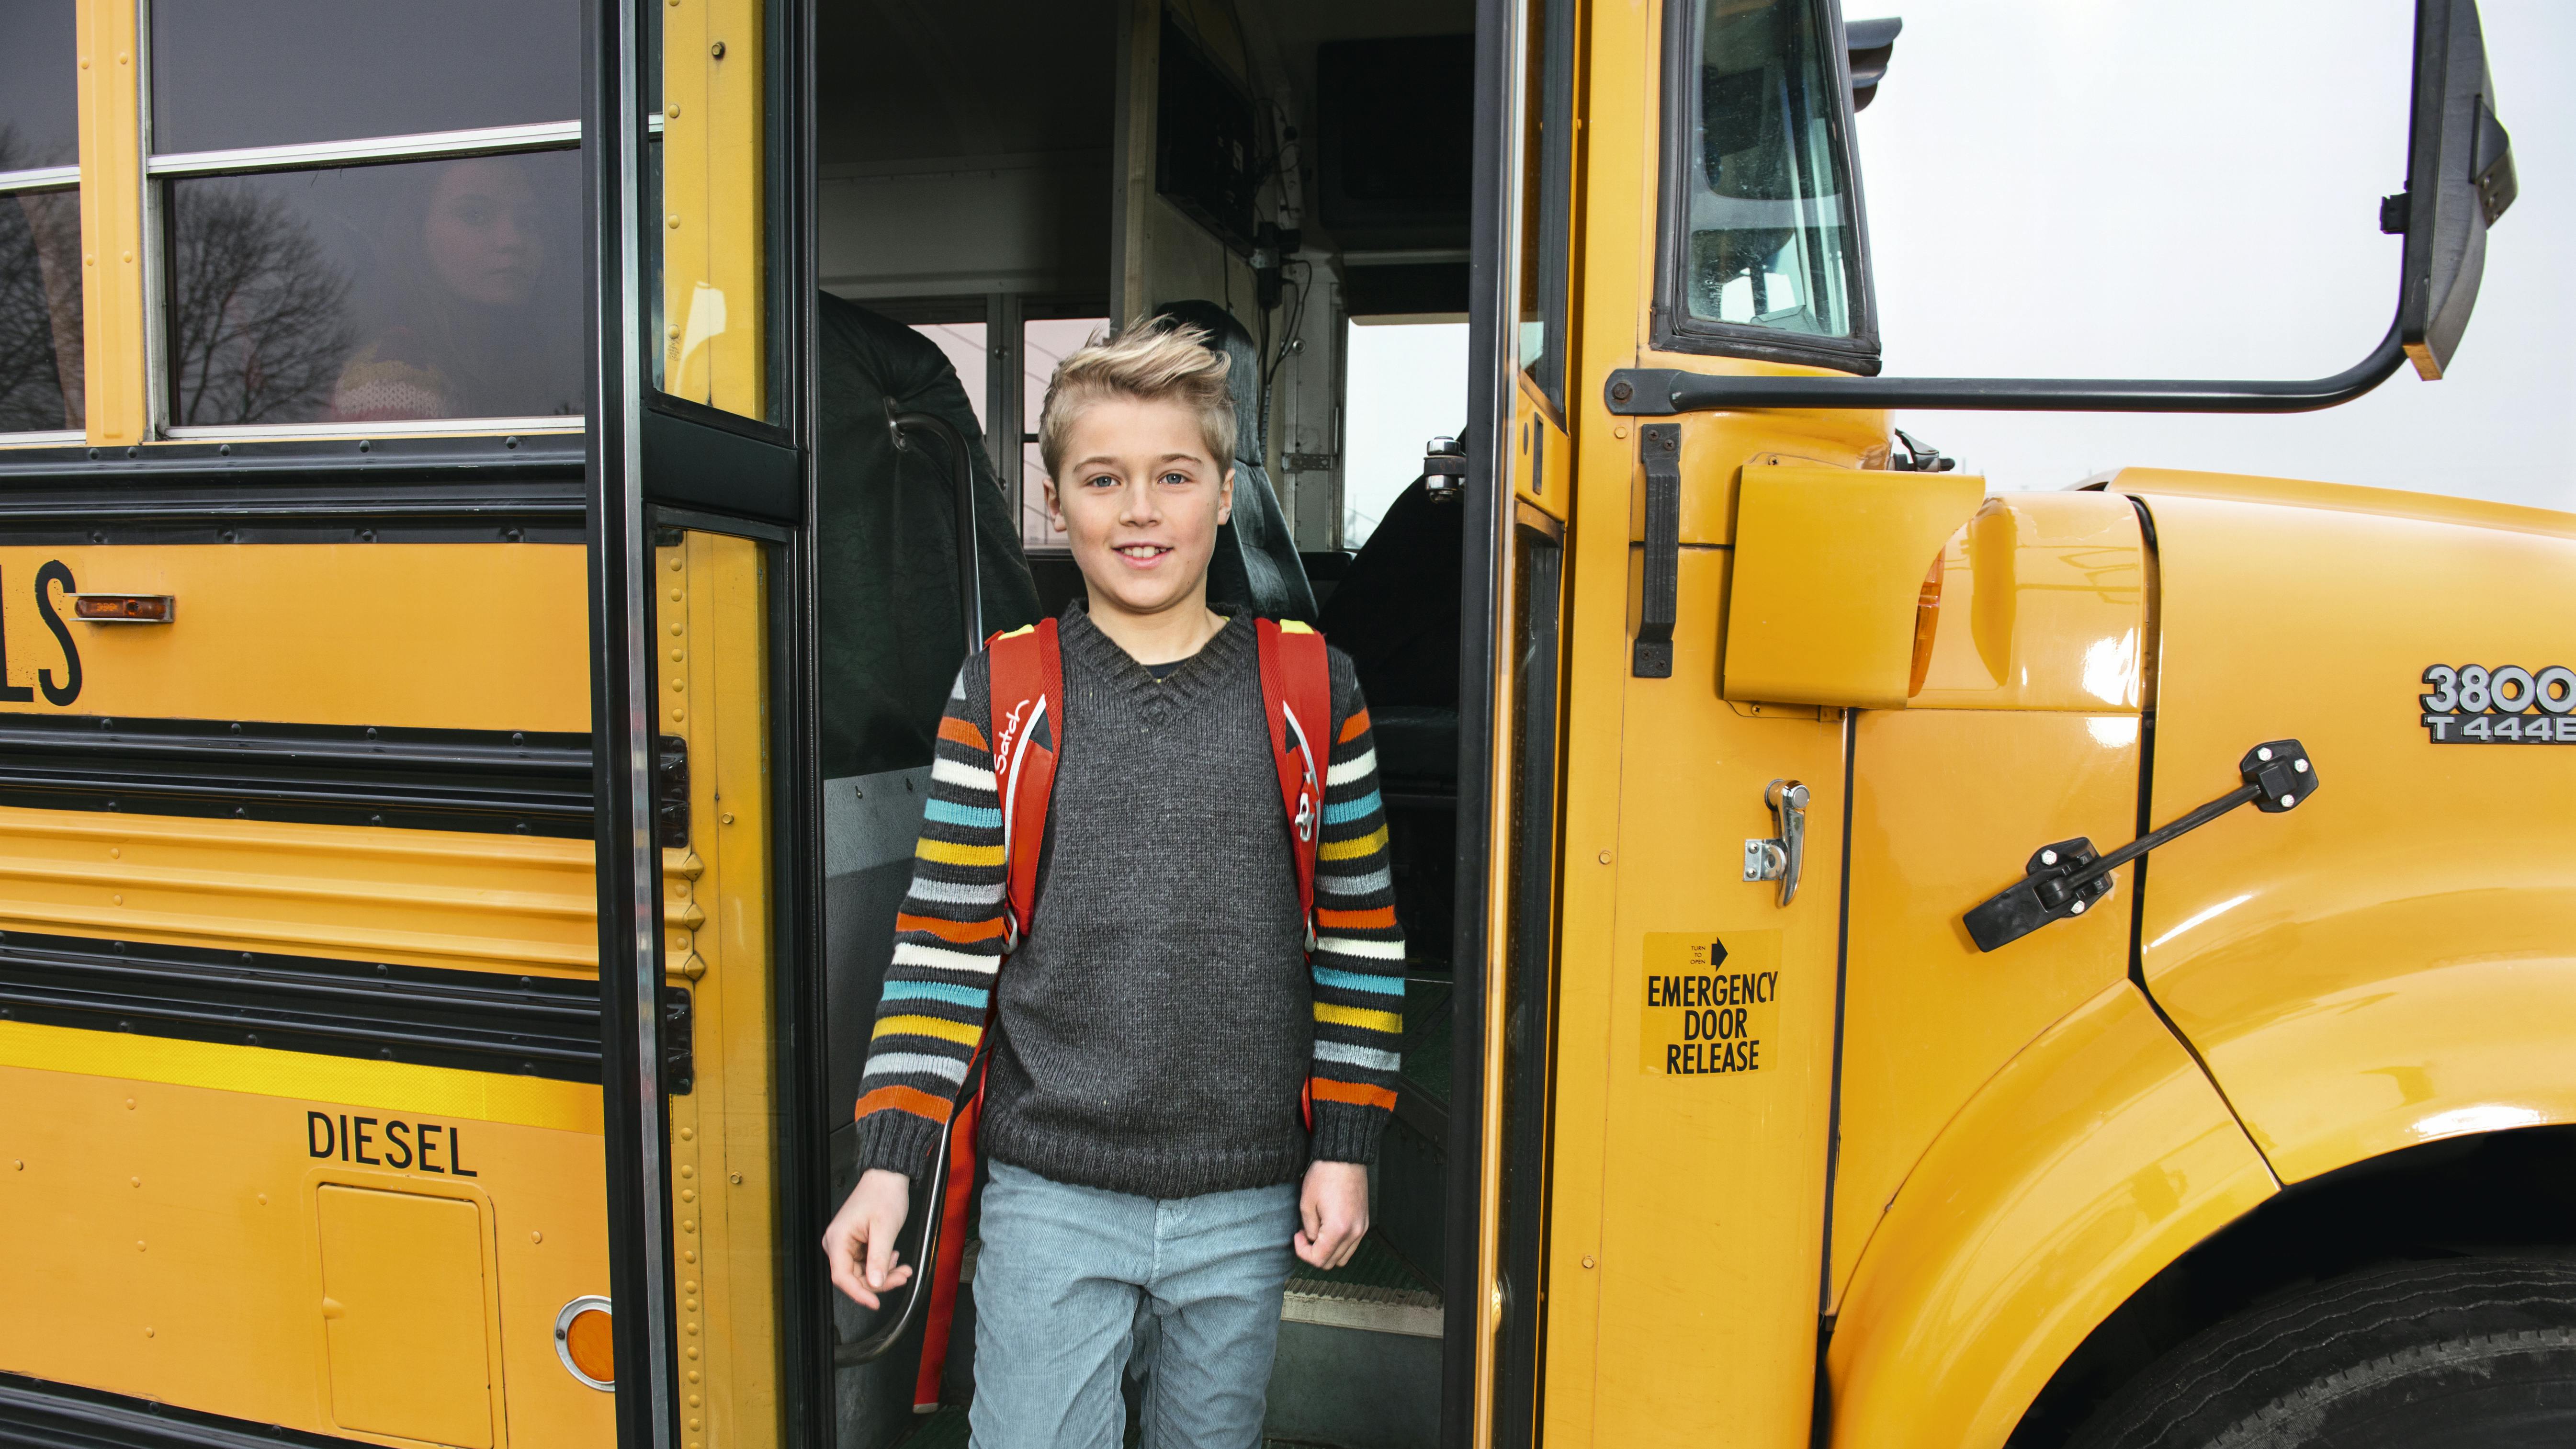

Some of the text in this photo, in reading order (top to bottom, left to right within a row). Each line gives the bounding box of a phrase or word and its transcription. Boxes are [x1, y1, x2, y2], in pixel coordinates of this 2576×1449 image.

[2419, 664, 2576, 713] 3800
[2421, 716, 2576, 741] T 444E
[1648, 971, 1778, 1007] EMERGENCY
[1684, 1008, 1748, 1041] DOOR
[1667, 1040, 1760, 1074] RELEASE
[307, 1110, 477, 1177] DIESEL
